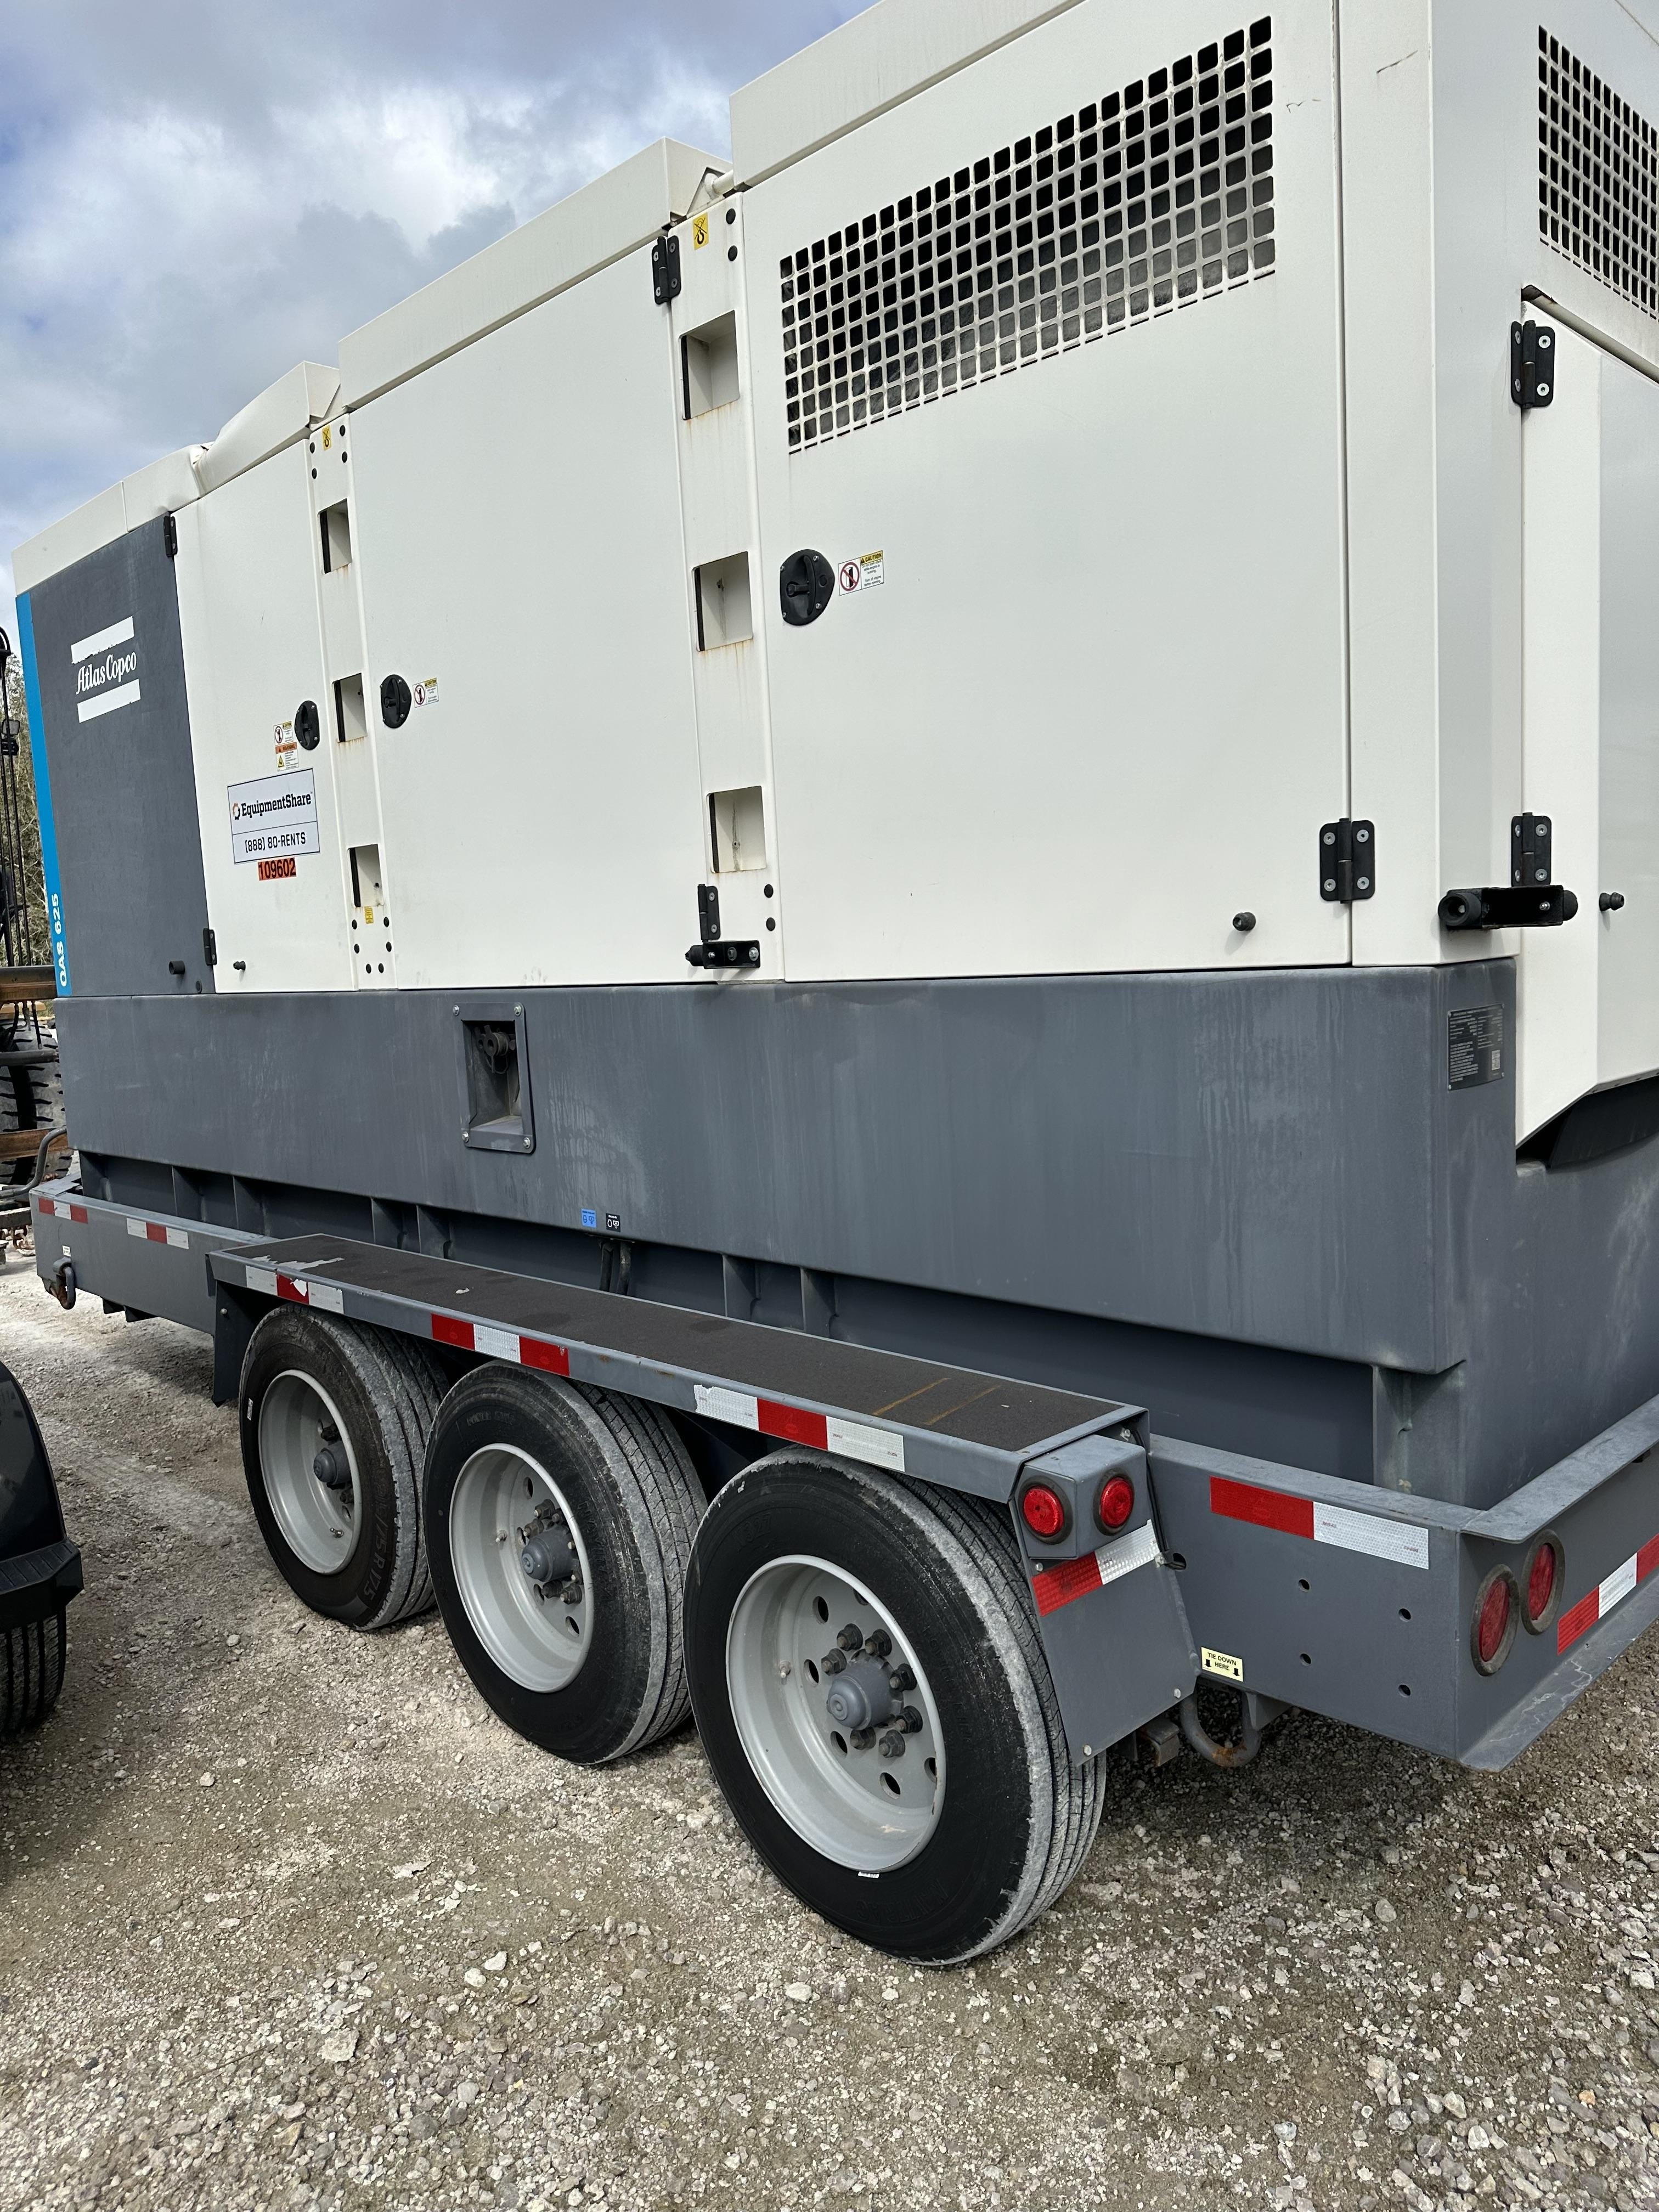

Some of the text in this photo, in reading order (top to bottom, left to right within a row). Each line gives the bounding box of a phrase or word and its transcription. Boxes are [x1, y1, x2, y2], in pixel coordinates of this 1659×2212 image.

[865, 553, 882, 562] CAUTION
[76, 652, 137, 695] Atlas Copco
[241, 793, 312, 819] EquipmentShare
[245, 832, 306, 853] (888) 80-RENTS
[258, 857, 296, 879] 109602
[52, 893, 62, 934] 625
[1214, 1661, 1229, 1671] HERE
[1217, 1656, 1237, 1666] DOWN
